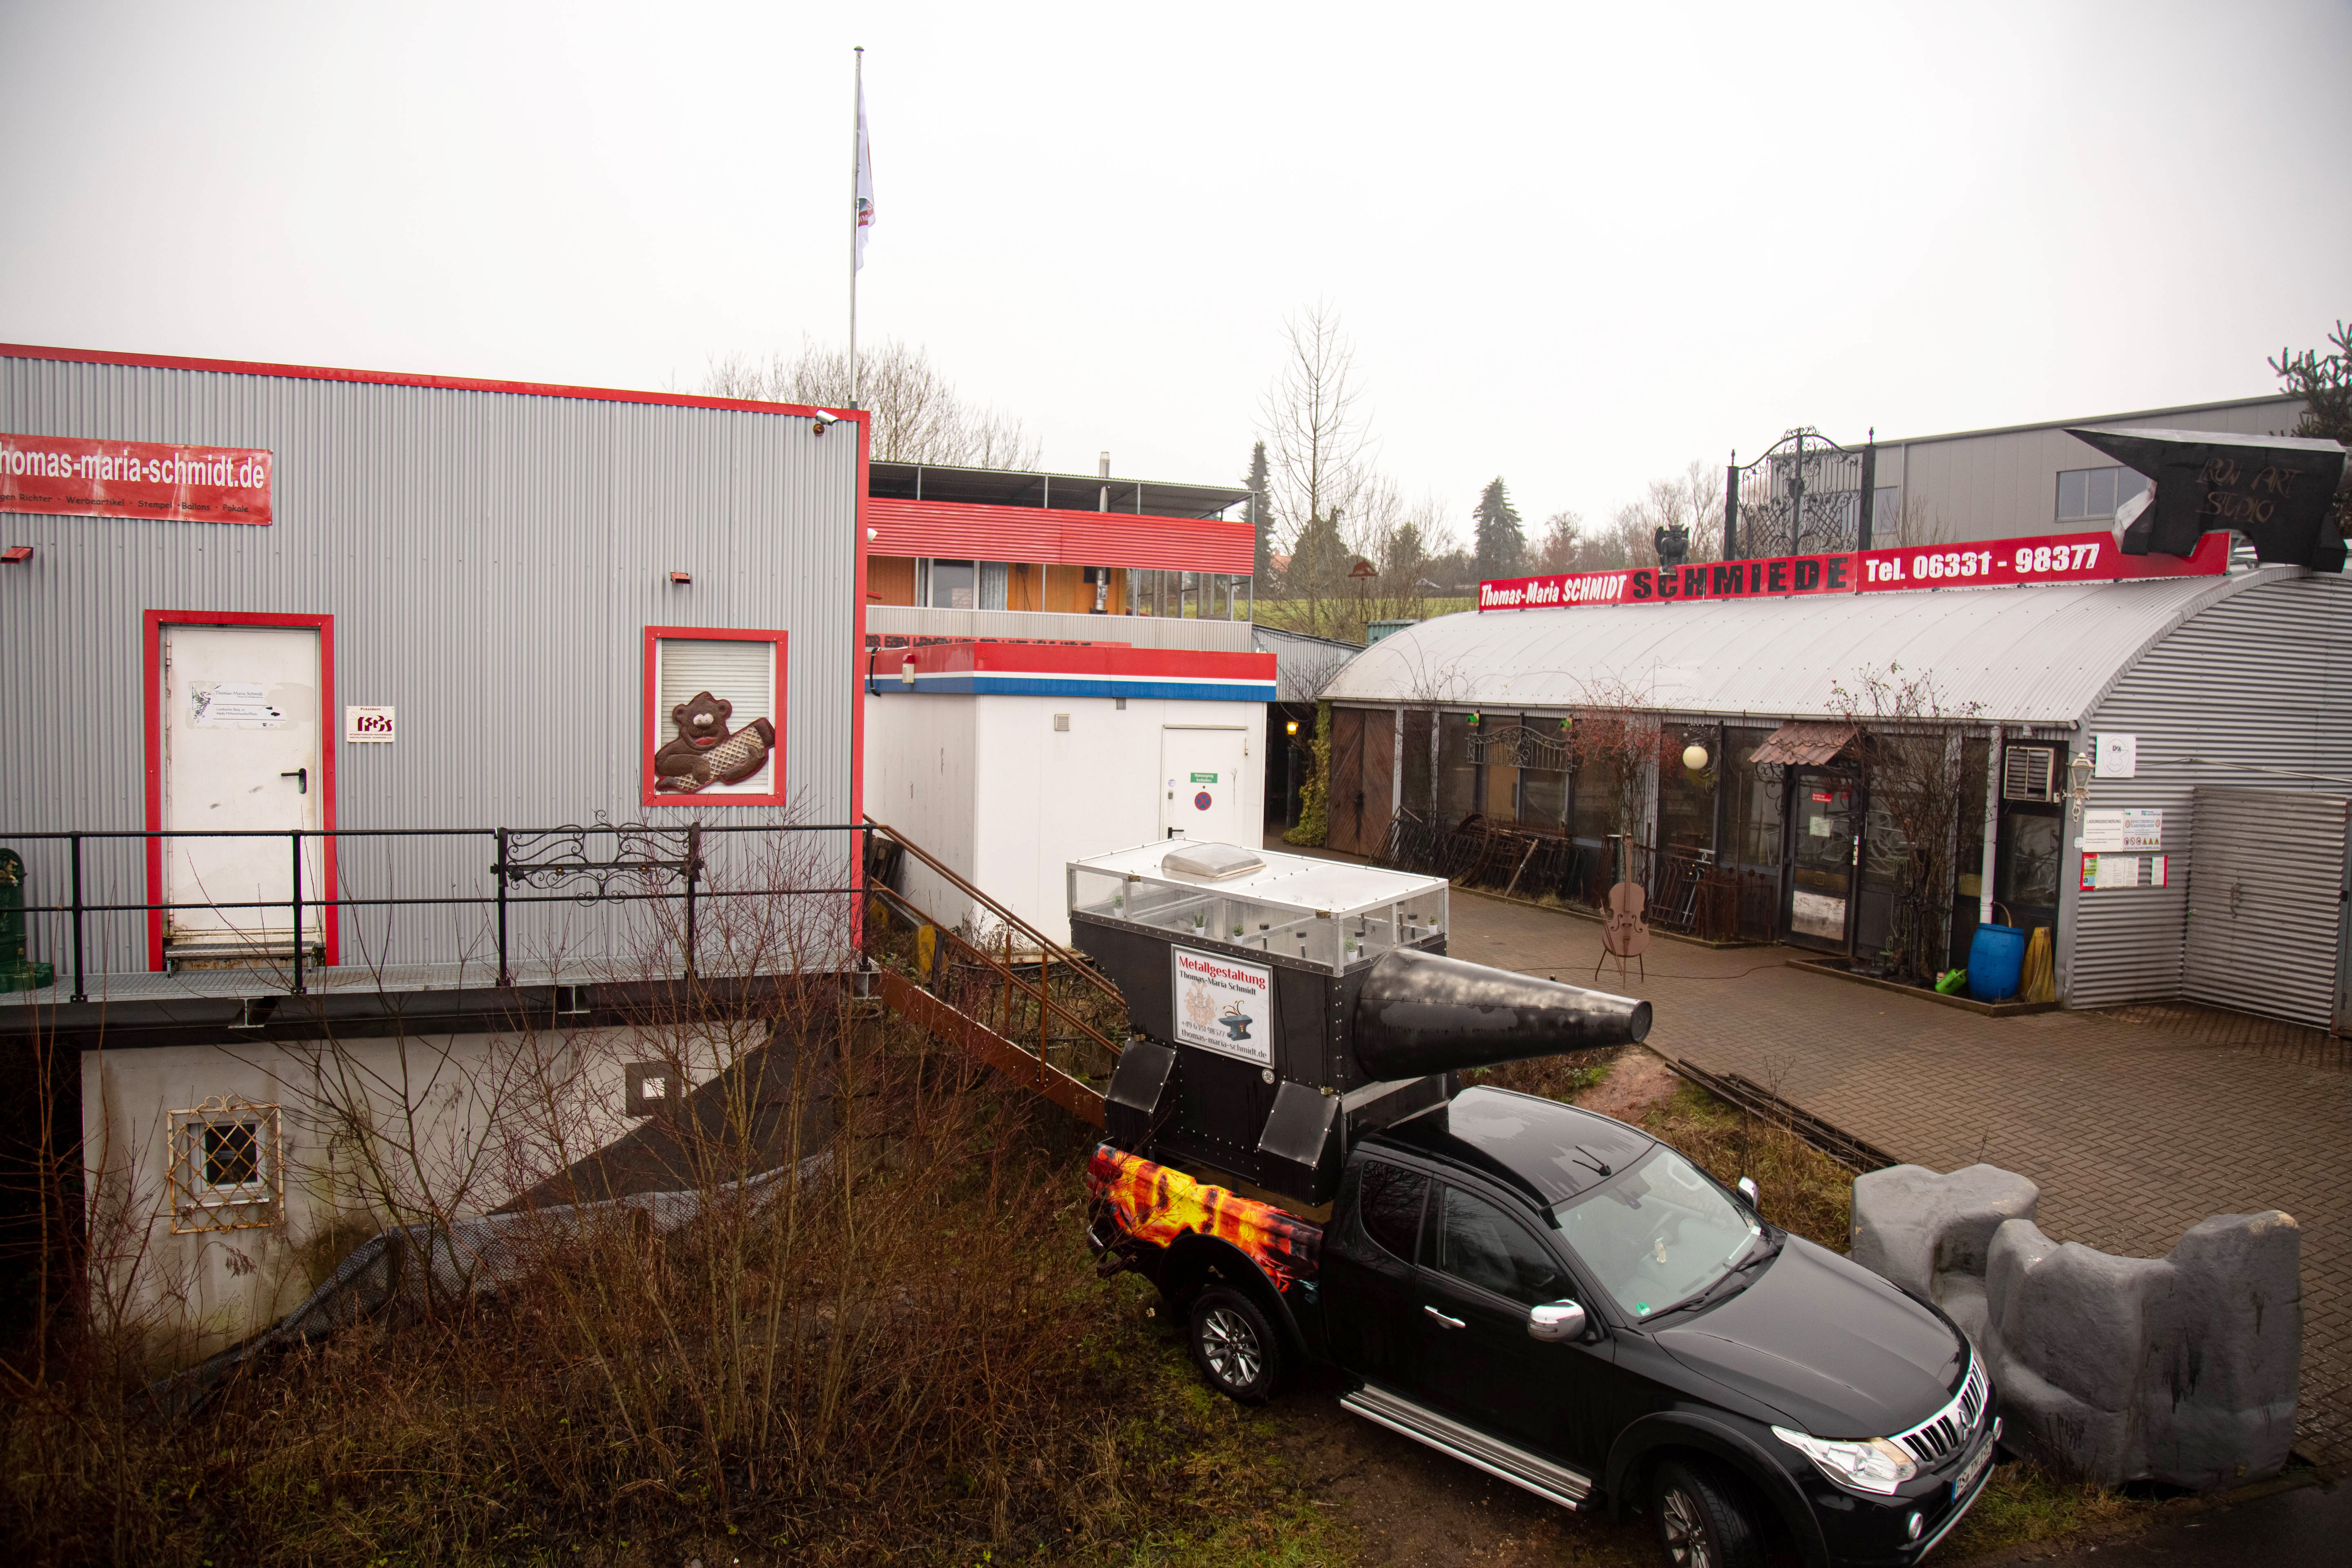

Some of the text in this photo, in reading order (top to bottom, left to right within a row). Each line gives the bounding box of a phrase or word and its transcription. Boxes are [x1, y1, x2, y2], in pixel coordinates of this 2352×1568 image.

[2195, 458, 2303, 499] IRON ART
[20, 494, 52, 502] Richter
[66, 497, 124, 506] Werbeartikel
[138, 500, 172, 510] Stempel
[182, 502, 210, 510] Ballons
[223, 504, 248, 512] Pokale
[1633, 557, 1848, 599] SCHMIEDE
[1866, 558, 1906, 582] Tel.
[1913, 551, 1992, 579] 06331
[2015, 543, 2100, 573] 98377
[1481, 575, 1627, 606] Thomas-Maria SCHMIDT
[1179, 956, 1265, 990] Metallgestaltung
[1179, 970, 1256, 996] Thomas-Maria Schmidt
[1181, 1029, 1267, 1059] thomas-maria-schmidt.de
